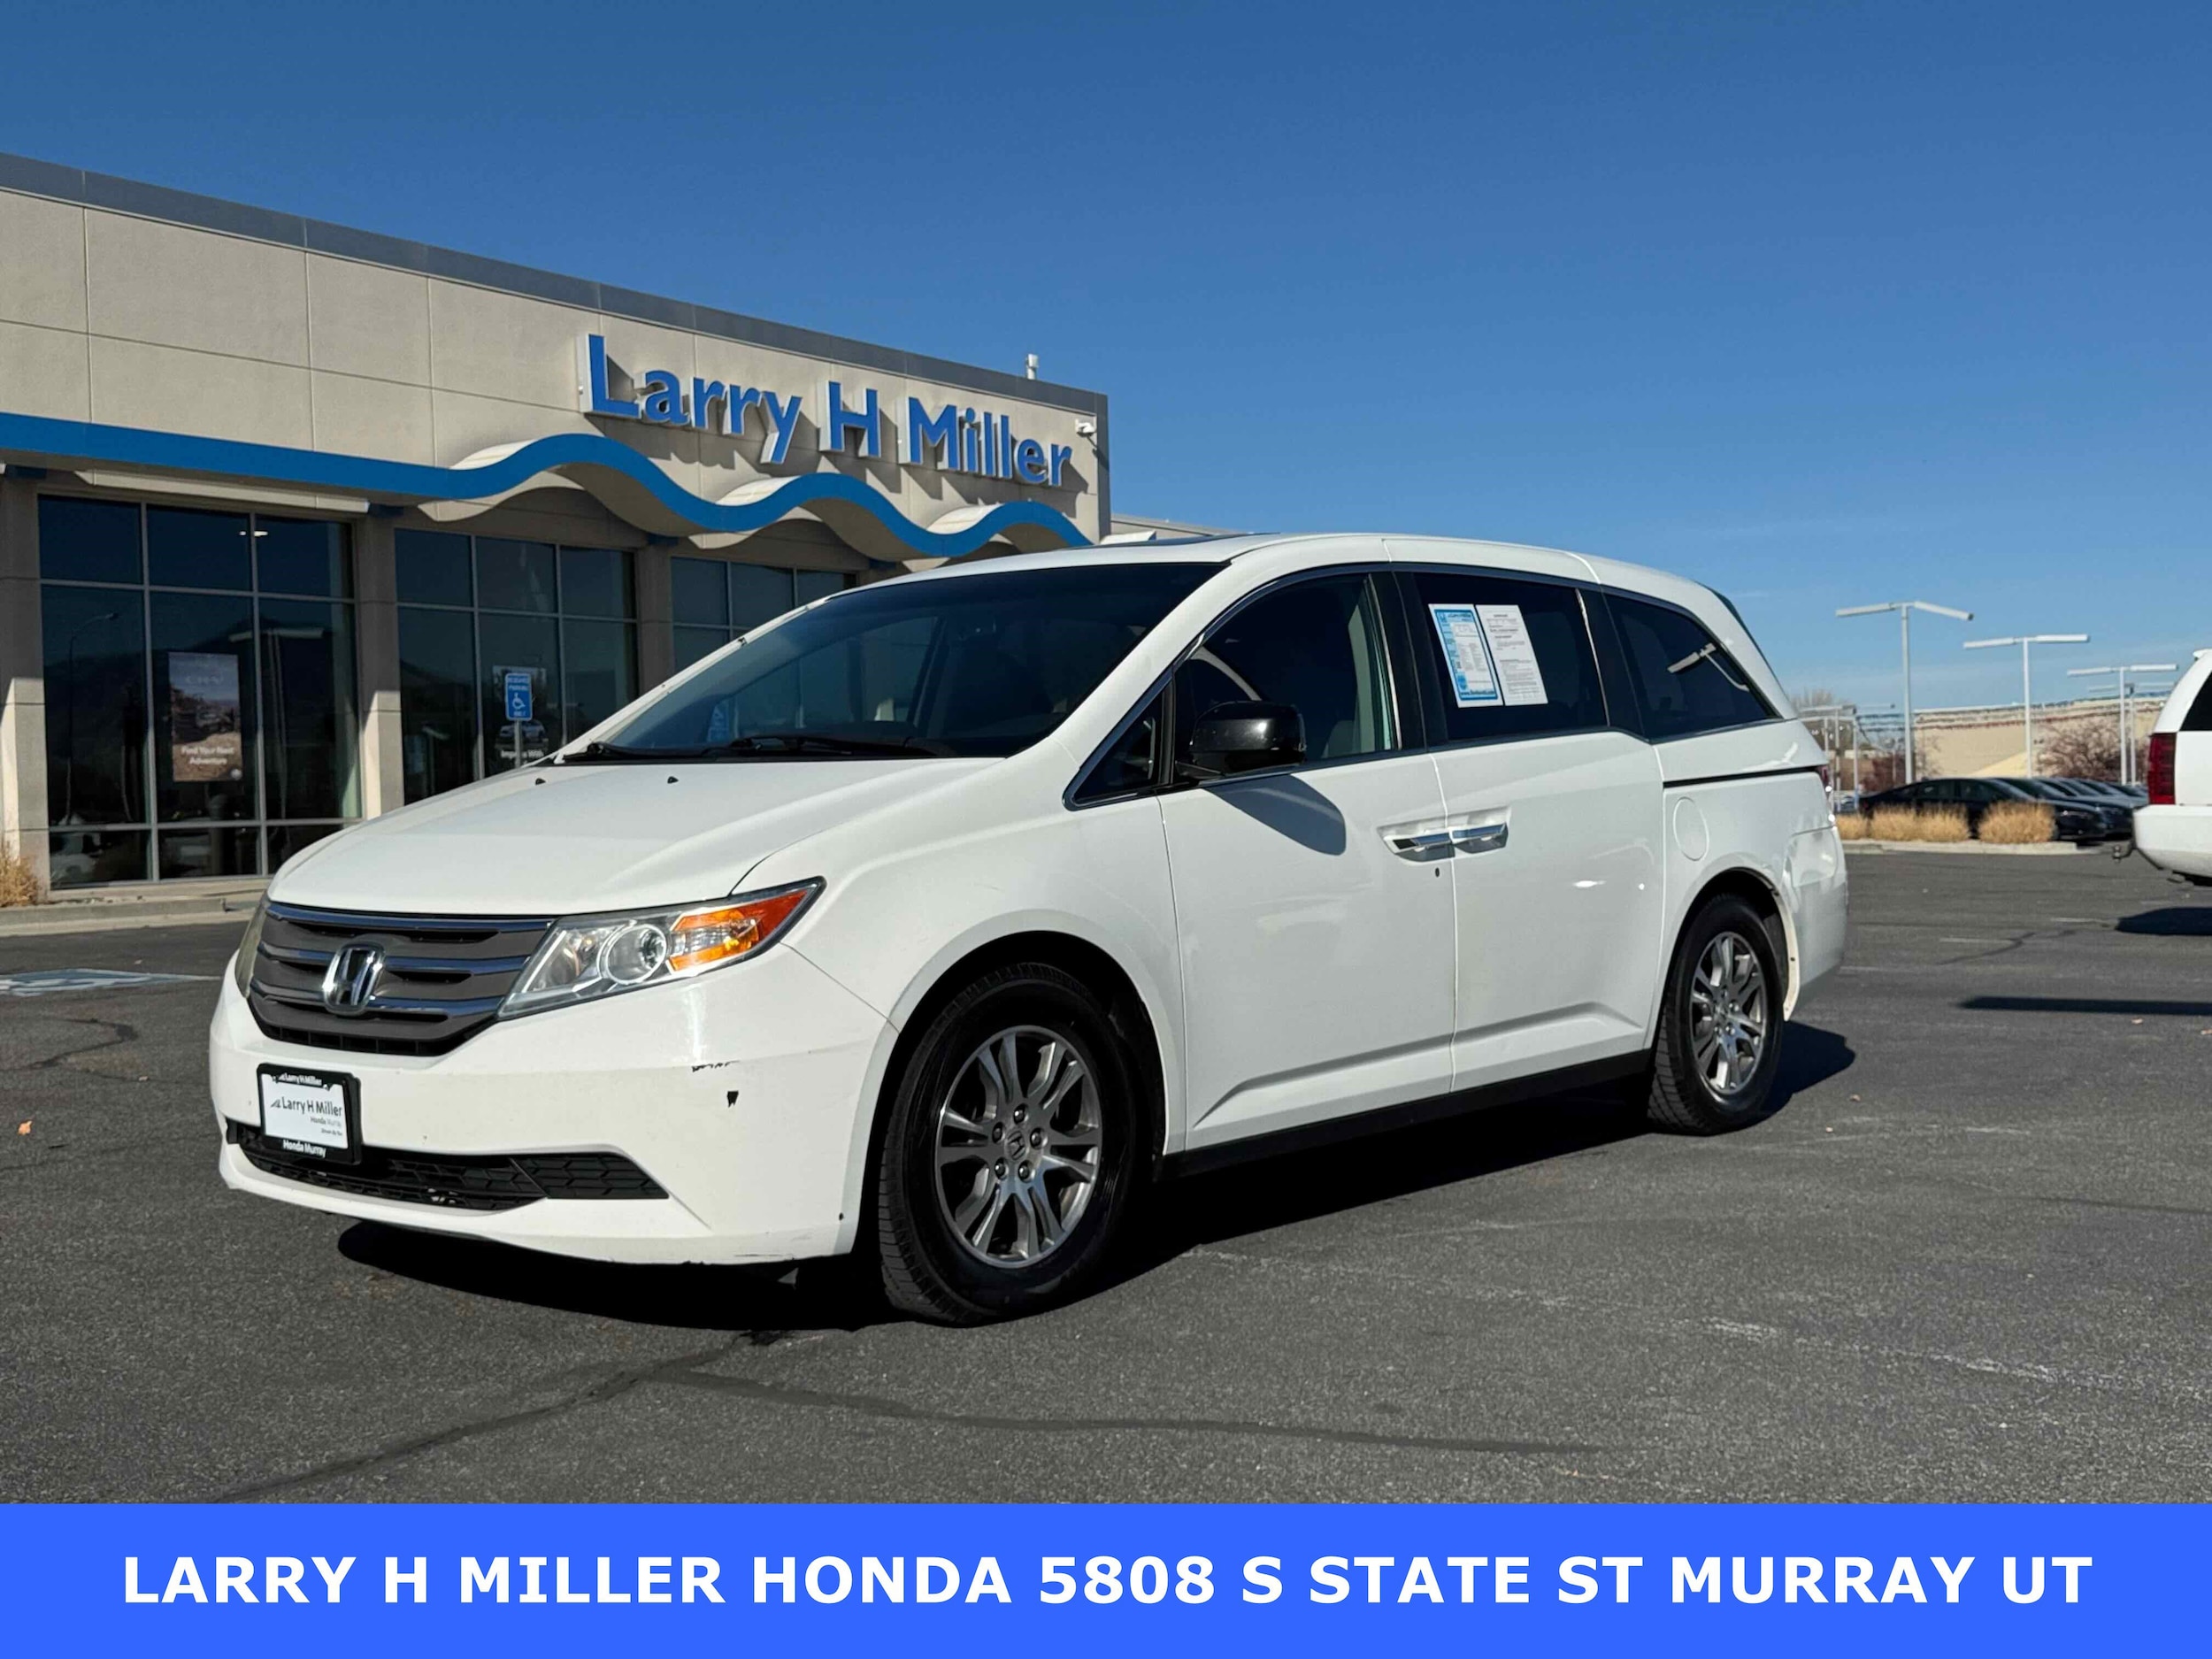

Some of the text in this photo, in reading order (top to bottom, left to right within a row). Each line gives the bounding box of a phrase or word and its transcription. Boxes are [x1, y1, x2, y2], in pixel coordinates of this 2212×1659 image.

[580, 334, 1072, 488] Larry H Miller
[281, 1096, 342, 1117] Larry H Miller
[283, 1139, 327, 1159] Honda Murray
